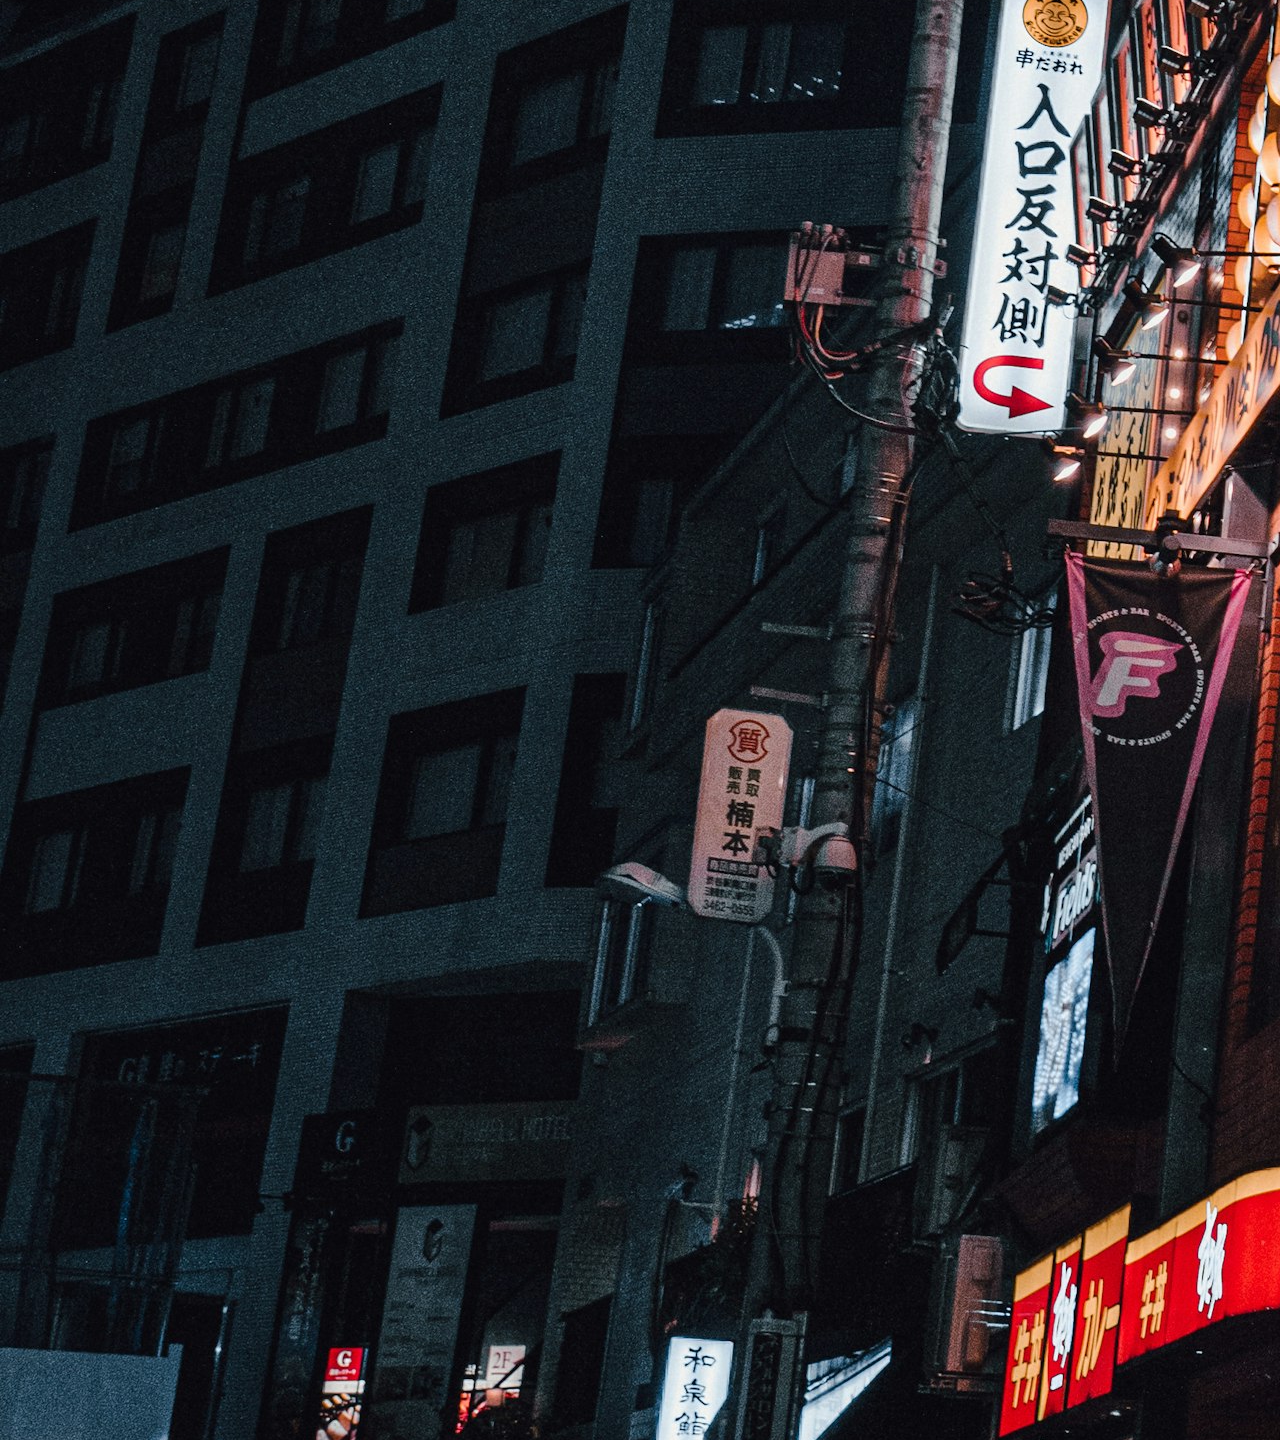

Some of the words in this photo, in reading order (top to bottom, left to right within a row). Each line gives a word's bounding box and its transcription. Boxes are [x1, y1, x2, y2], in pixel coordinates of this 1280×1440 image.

[1016, 47, 1084, 76] 串だおれ
[990, 83, 1070, 348] 入口反対側
[738, 727, 763, 755] 質
[725, 765, 744, 795] 販売
[745, 767, 762, 798] 買取
[721, 798, 756, 857] 楠本
[1140, 1261, 1169, 1340] 牛丼
[337, 1350, 353, 1367] G
[1011, 1309, 1046, 1410] 牛丼
[1075, 1278, 1121, 1381] カレー
